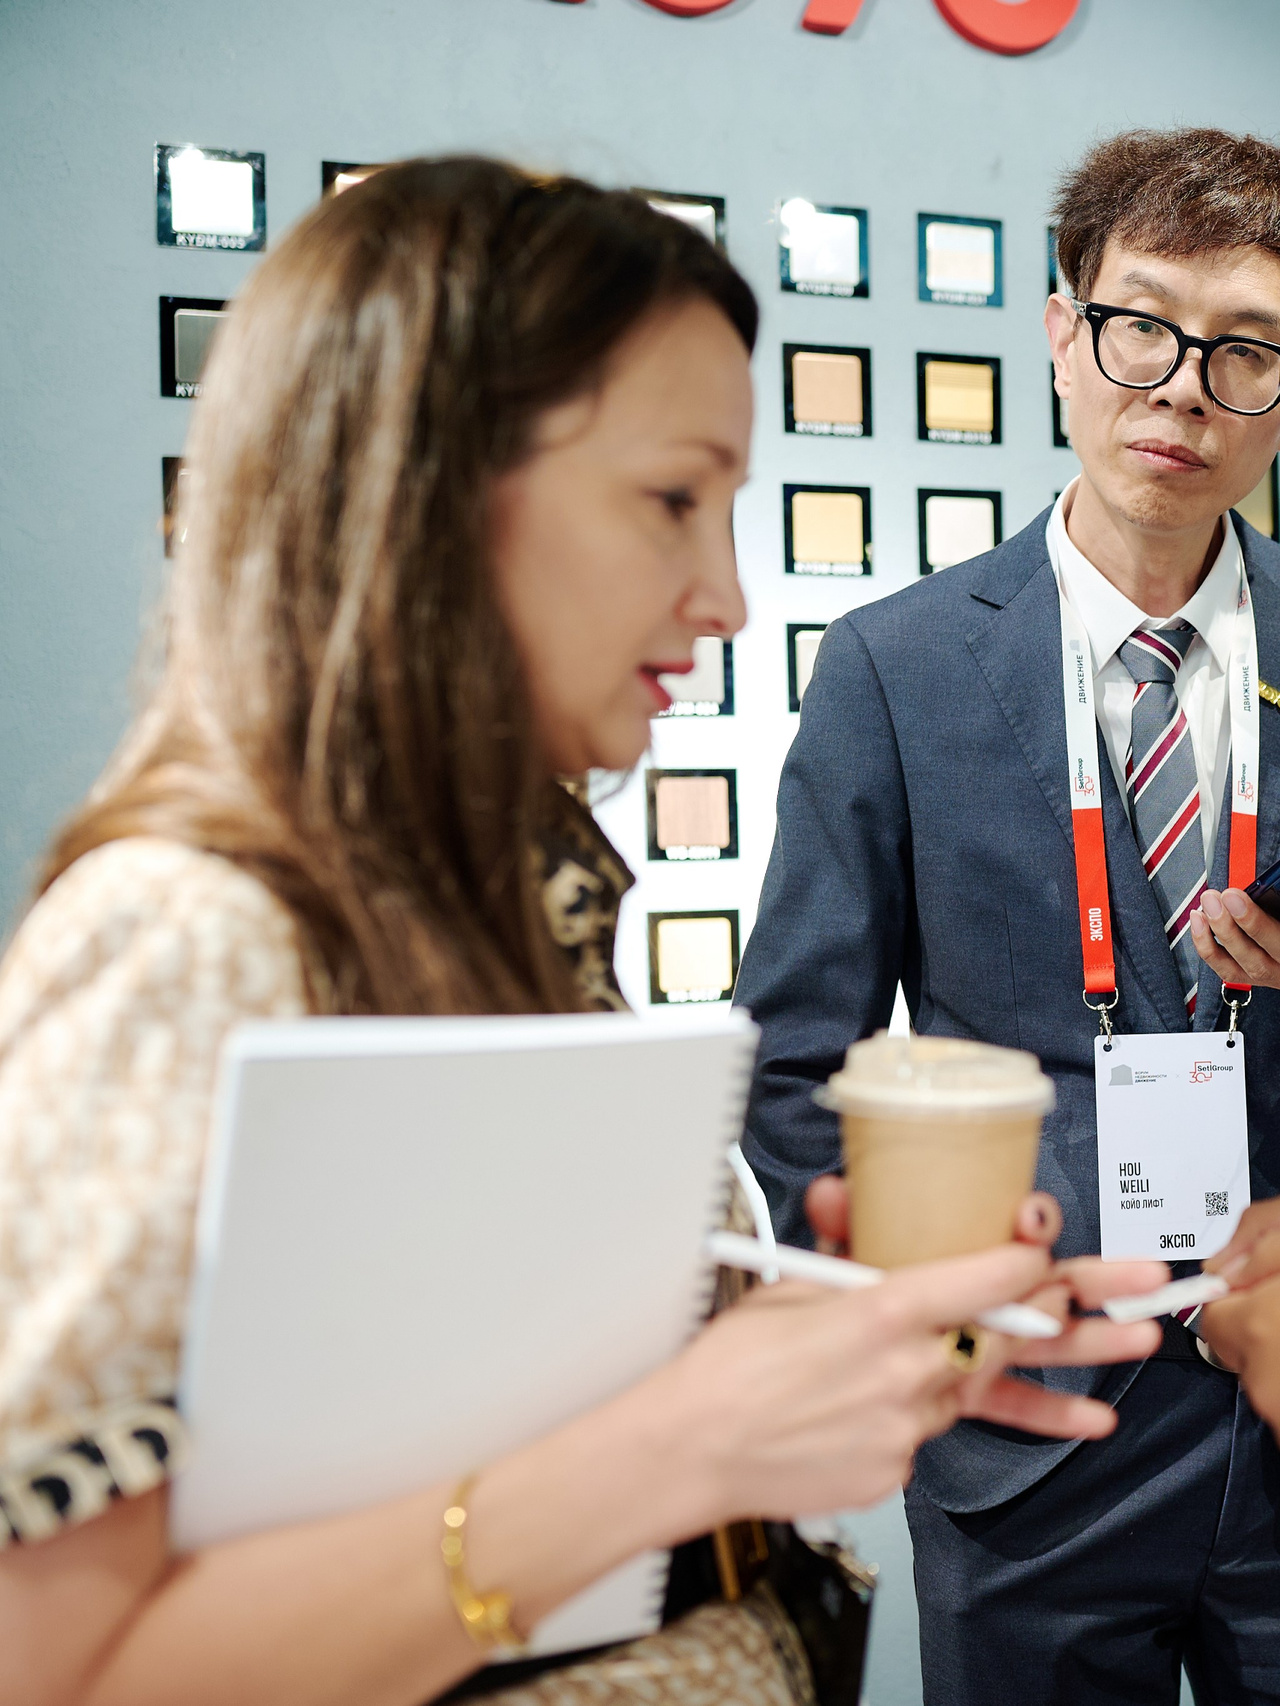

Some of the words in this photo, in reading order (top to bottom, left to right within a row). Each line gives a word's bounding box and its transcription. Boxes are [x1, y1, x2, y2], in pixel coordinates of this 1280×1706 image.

[1076, 654, 1087, 704] ДВИЖЕНИЕ
[1243, 665, 1251, 712] ДВИЖЕНИЕ
[1089, 907, 1103, 941] ЭКСПО
[1119, 1162, 1141, 1177] HOU
[1119, 1178, 1150, 1194] WEILI
[1120, 1198, 1141, 1210] КОЙО
[1142, 1198, 1164, 1209] ЛИФТ
[1159, 1233, 1196, 1249] ЭКСПО
